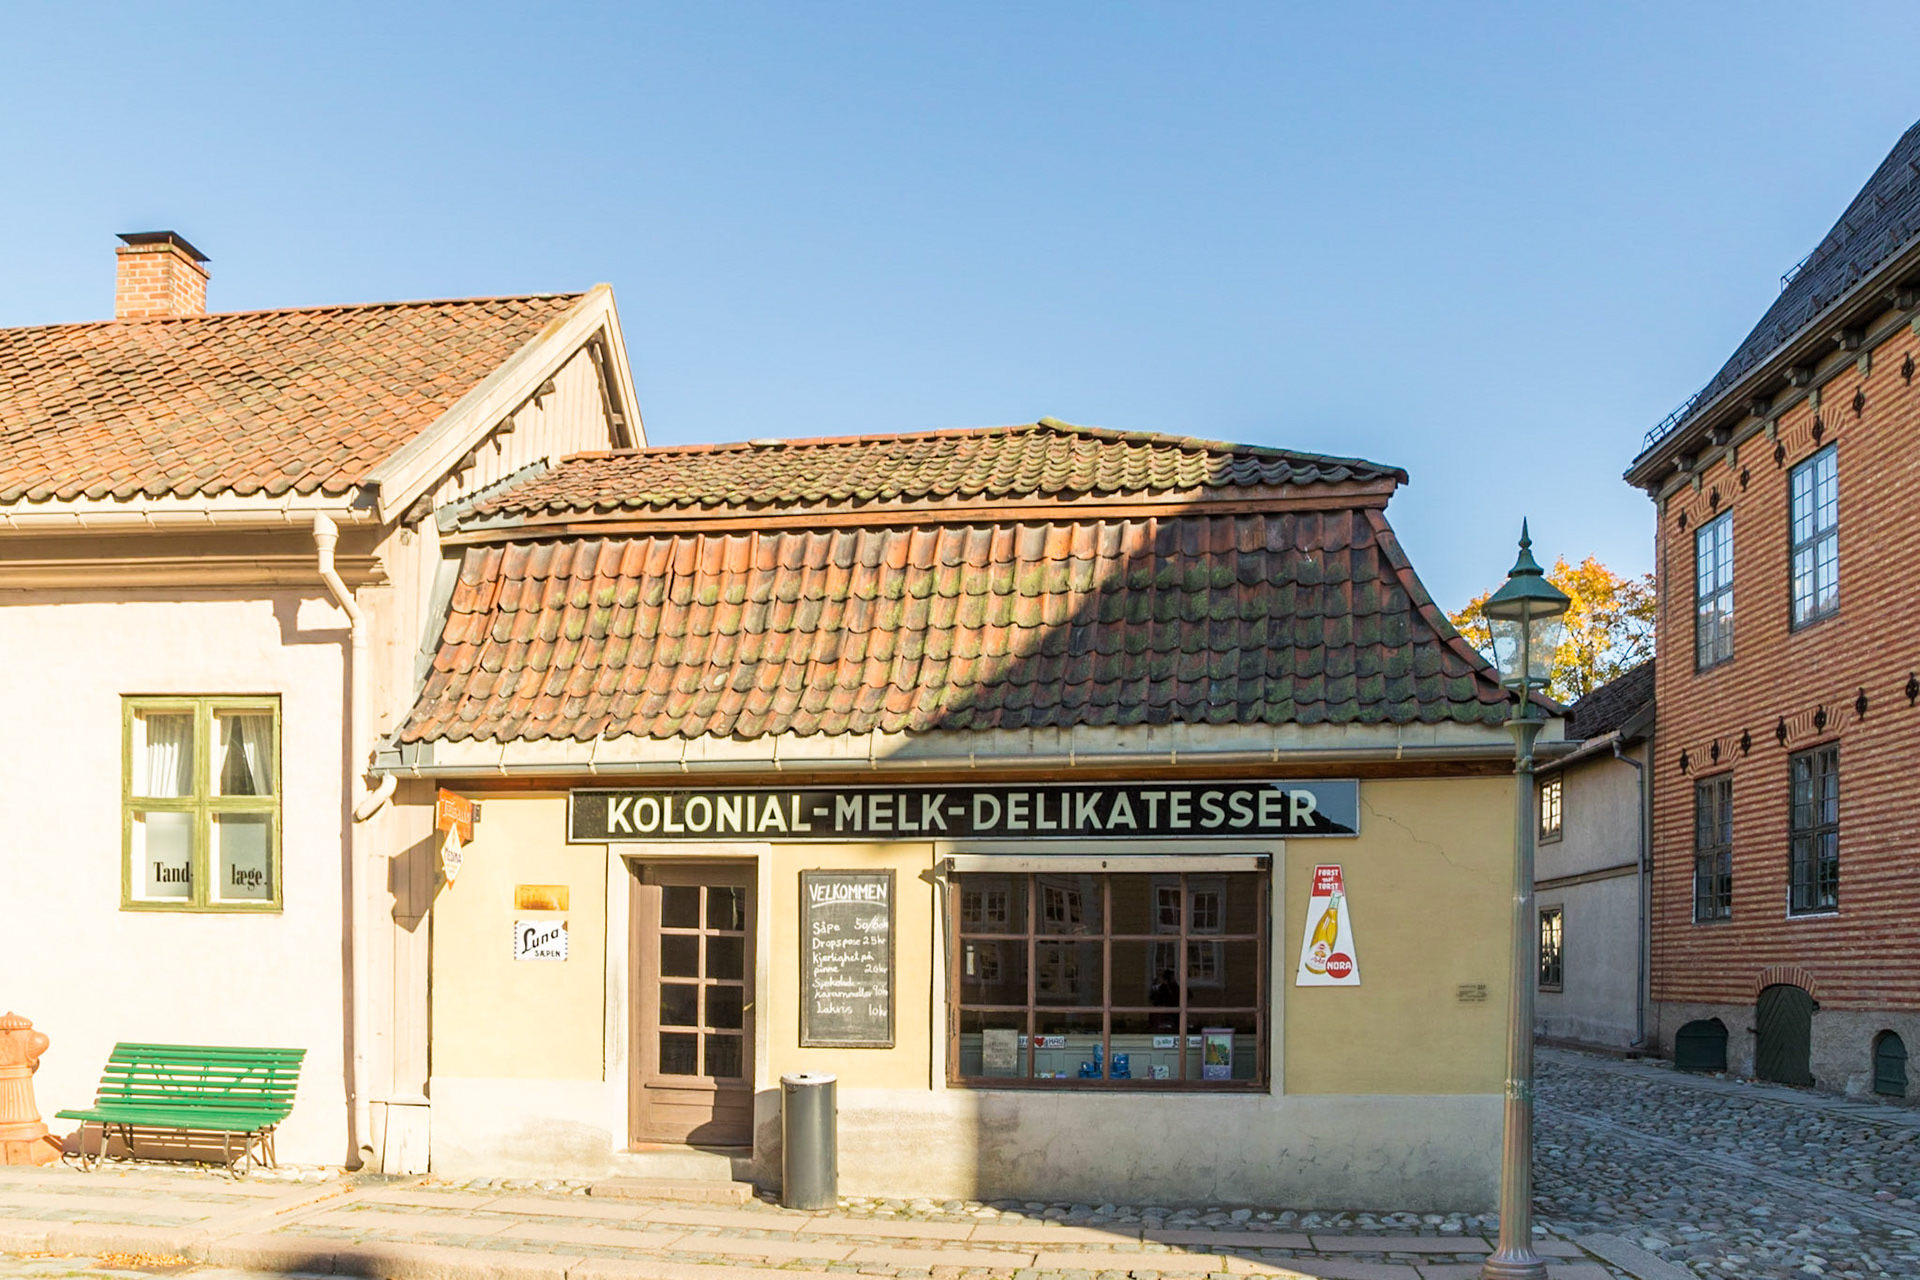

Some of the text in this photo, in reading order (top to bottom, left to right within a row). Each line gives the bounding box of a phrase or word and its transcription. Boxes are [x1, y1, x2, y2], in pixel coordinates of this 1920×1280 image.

[153, 861, 194, 883] Tand-
[809, 883, 887, 901] VELKOMMEN
[812, 921, 841, 935] Såpe
[522, 928, 560, 955] Luna
[535, 950, 561, 958] SÆPEN
[861, 951, 874, 962] på
[813, 966, 840, 977] pinne
[1326, 961, 1352, 970] NORA
[816, 1001, 853, 1014] Lakris
